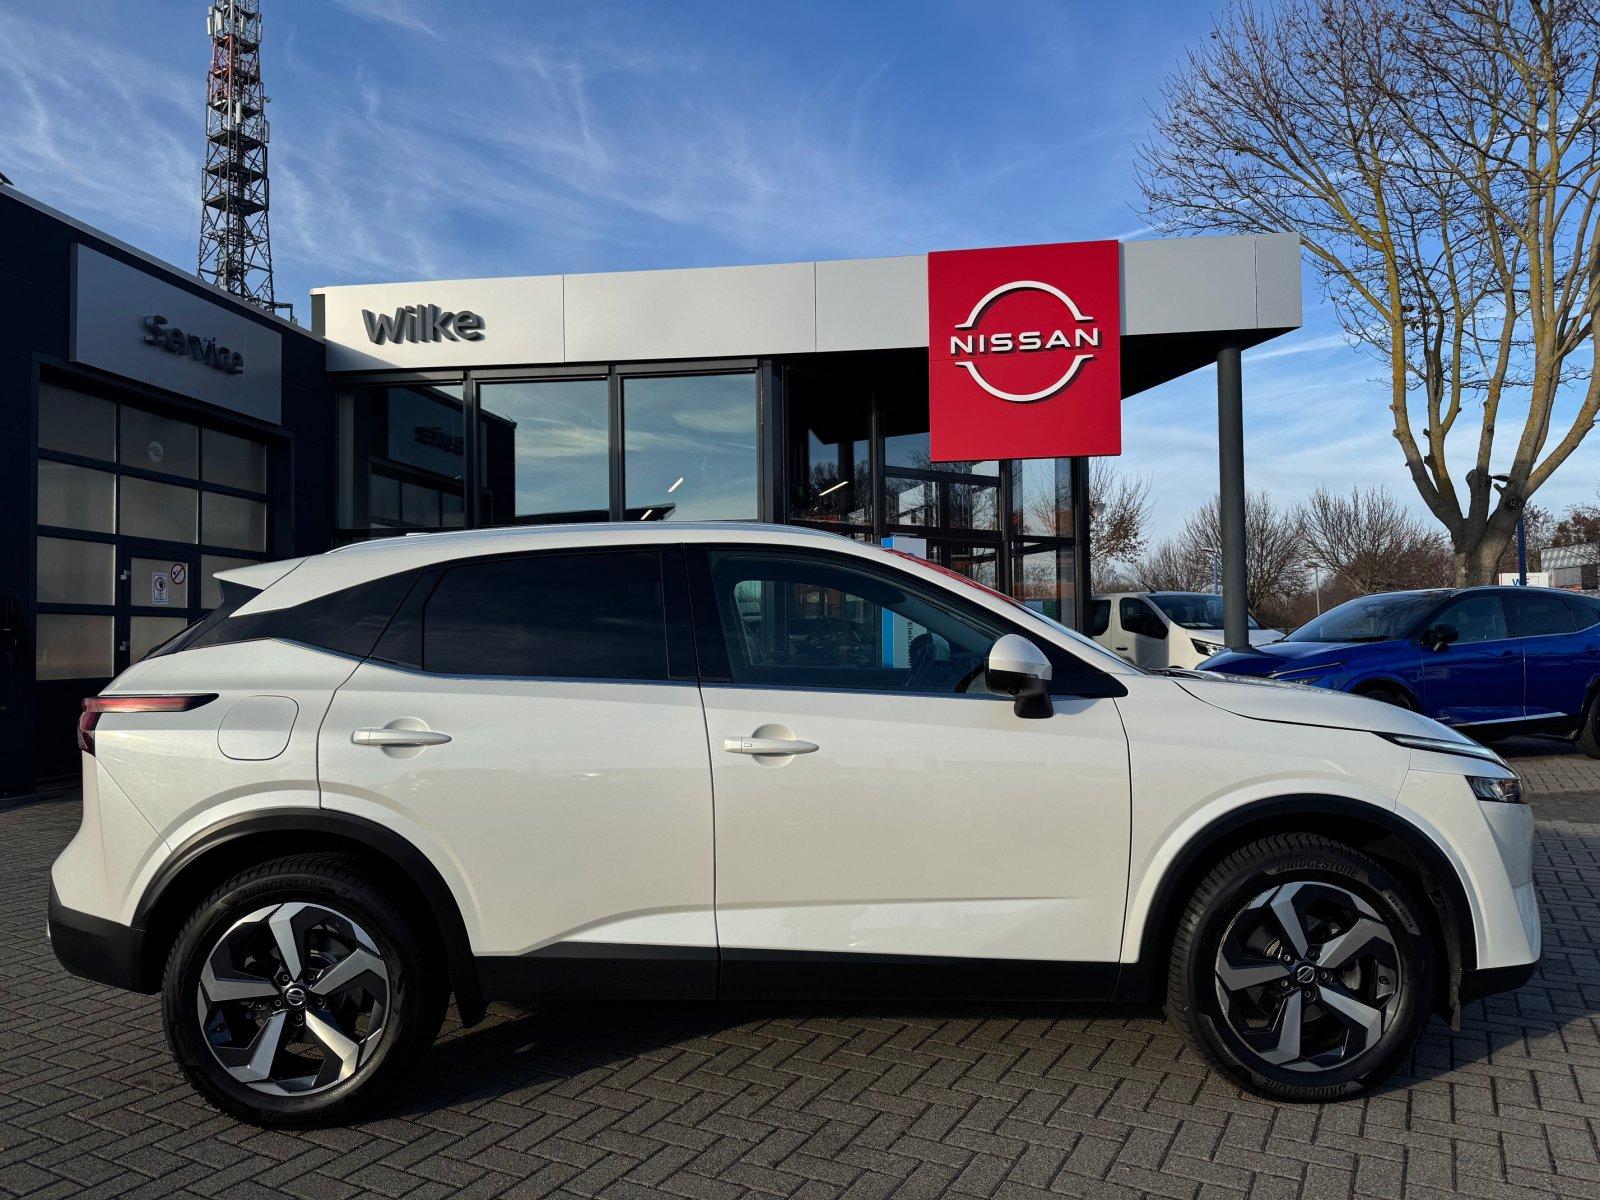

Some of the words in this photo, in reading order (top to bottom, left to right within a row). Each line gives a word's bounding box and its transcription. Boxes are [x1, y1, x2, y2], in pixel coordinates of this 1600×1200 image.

[143, 314, 246, 374] Service
[361, 303, 486, 345] Wilke
[950, 327, 1100, 355] NISSAN
